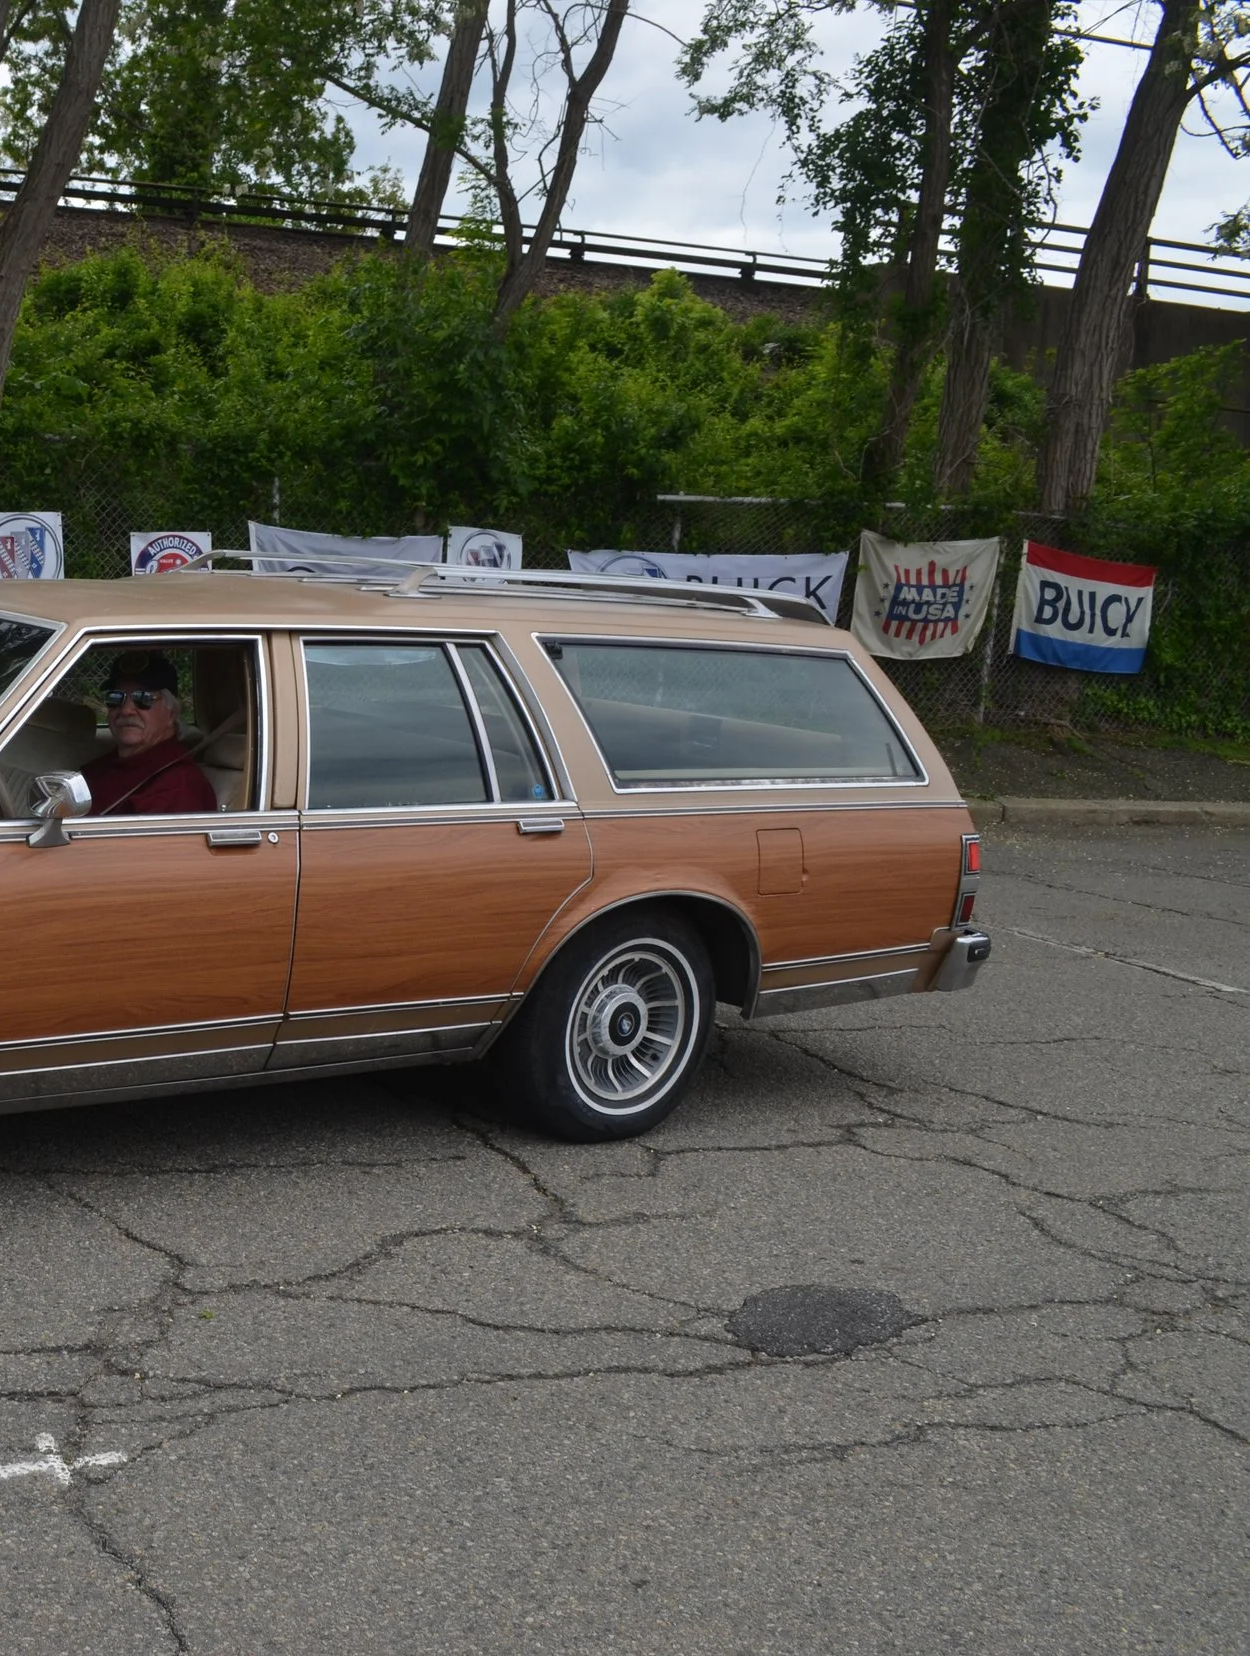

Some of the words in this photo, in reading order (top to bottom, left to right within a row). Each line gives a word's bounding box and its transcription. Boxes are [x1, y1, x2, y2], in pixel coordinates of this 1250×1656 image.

[147, 536, 197, 556] AUTHORIZED
[898, 586, 960, 603] MADE
[893, 605, 907, 615] IN
[908, 603, 956, 620] USA
